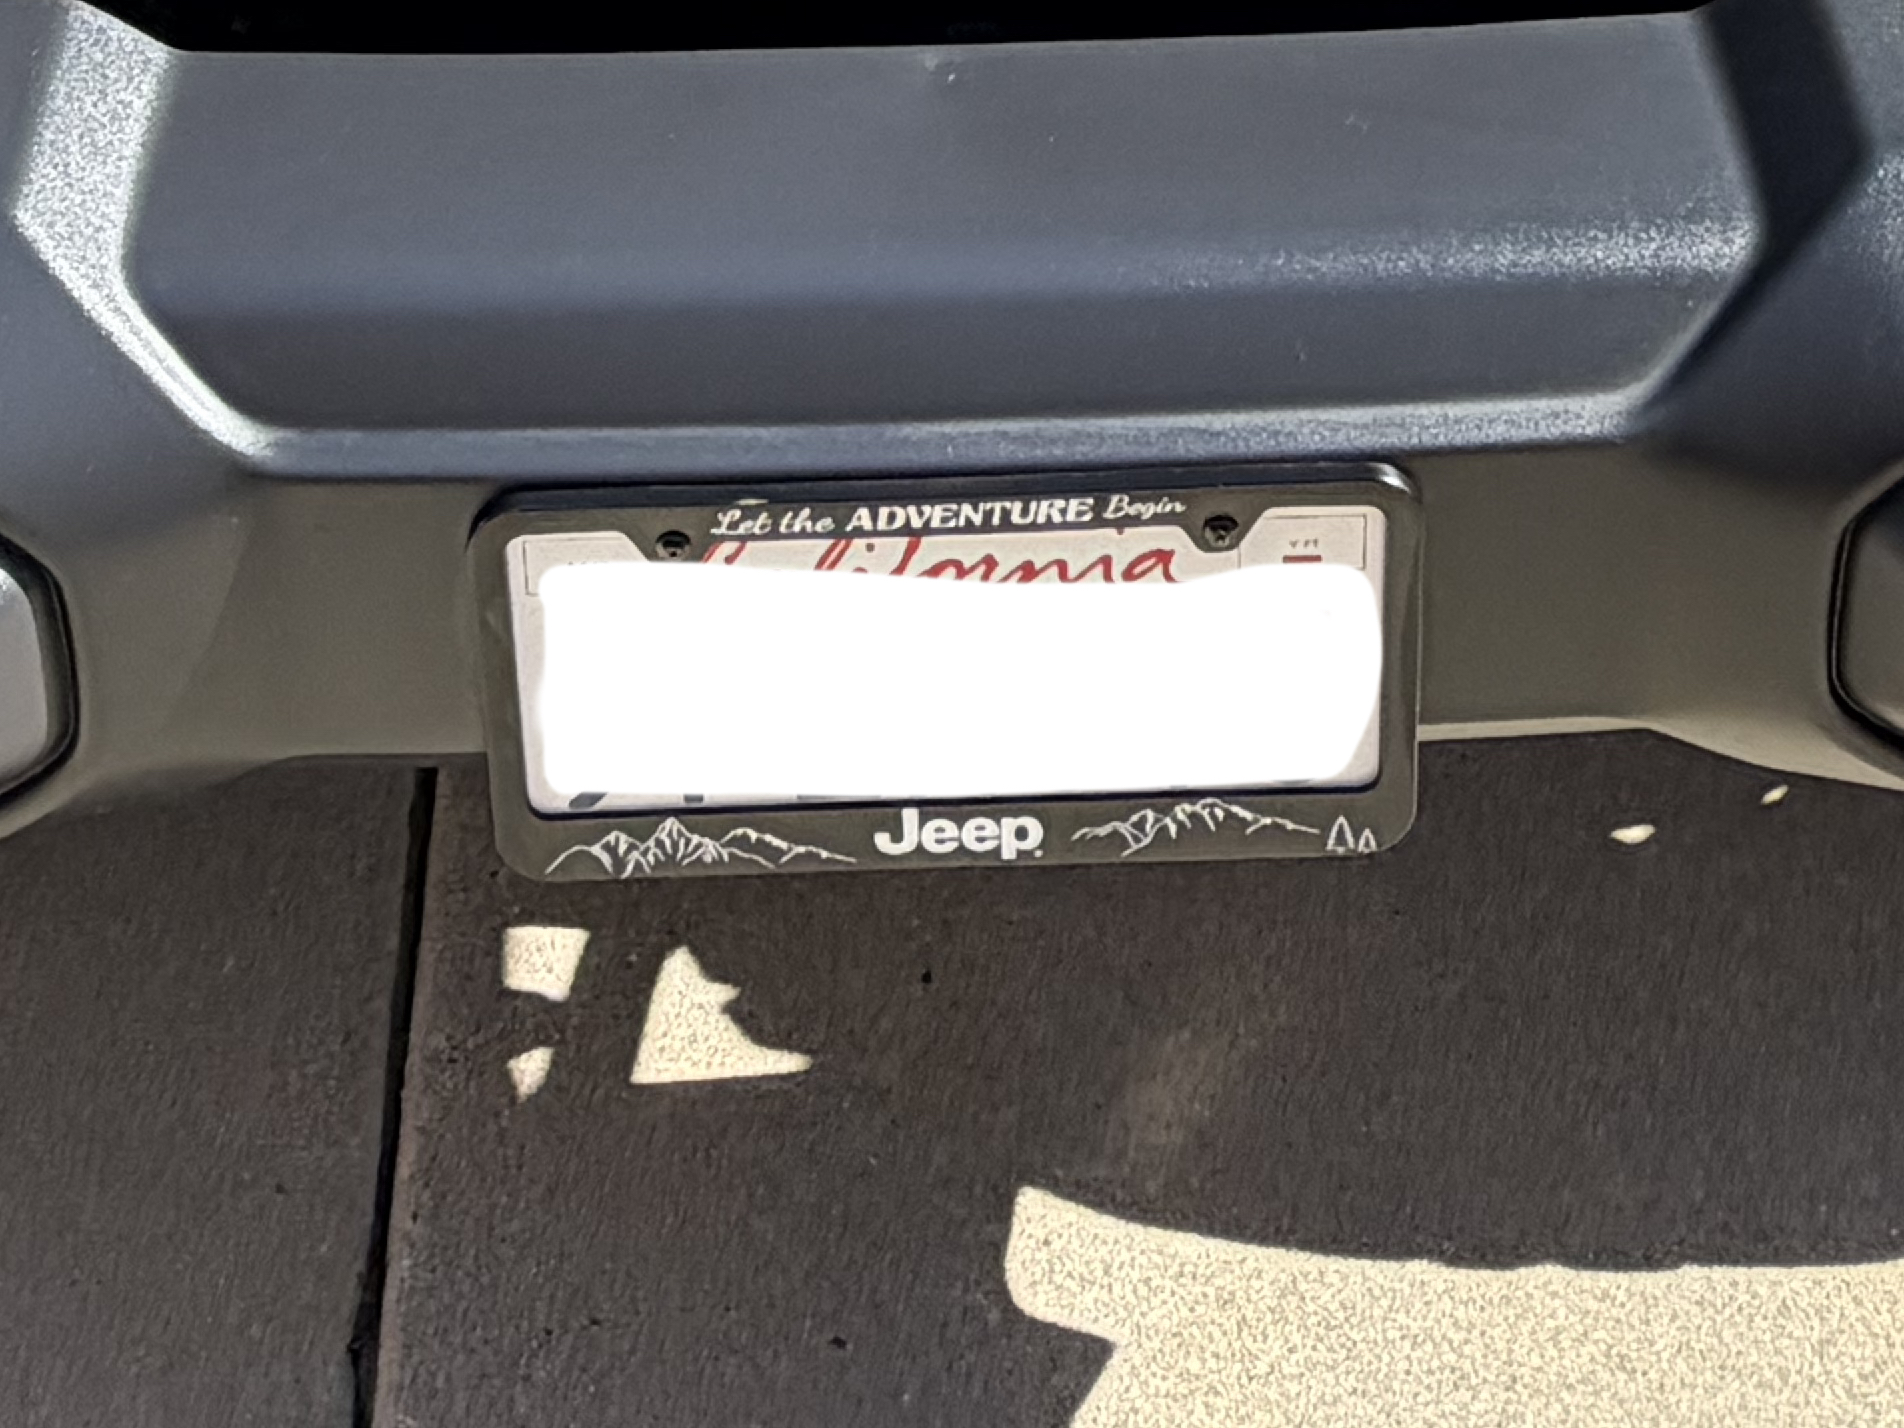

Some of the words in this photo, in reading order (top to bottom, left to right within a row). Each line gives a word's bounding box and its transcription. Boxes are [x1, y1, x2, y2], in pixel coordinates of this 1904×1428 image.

[709, 508, 772, 536] Let
[778, 506, 836, 534] the
[846, 497, 1094, 532] ADVENTURE
[1102, 494, 1187, 521] Begin
[873, 807, 1045, 860] Jeep
